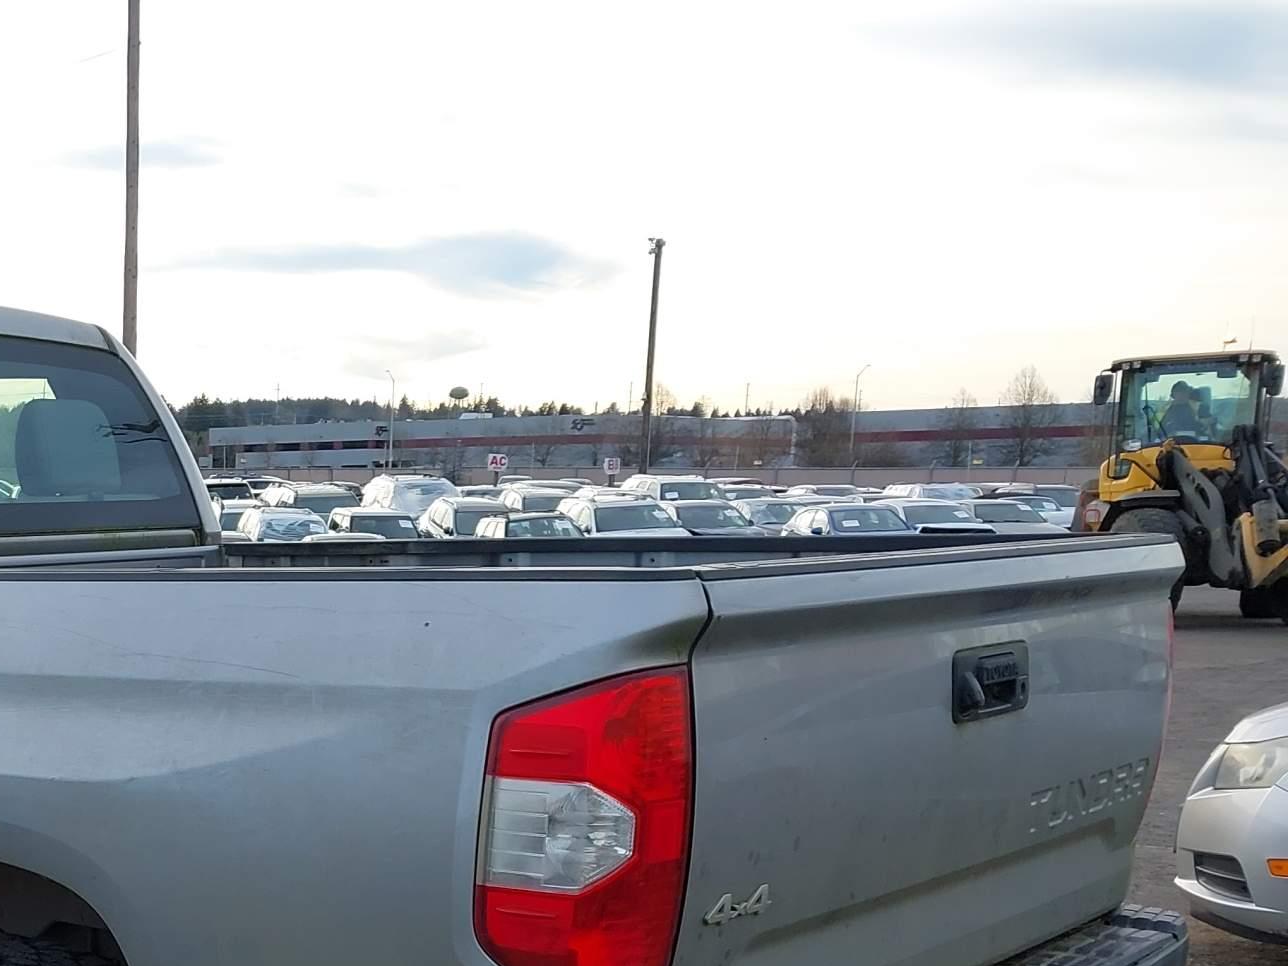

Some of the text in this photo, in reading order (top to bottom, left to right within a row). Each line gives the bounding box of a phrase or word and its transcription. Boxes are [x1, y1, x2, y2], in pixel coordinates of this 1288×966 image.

[489, 456, 507, 466] AC
[1030, 757, 1150, 833] TUNDRA
[703, 883, 772, 926] 4x4
